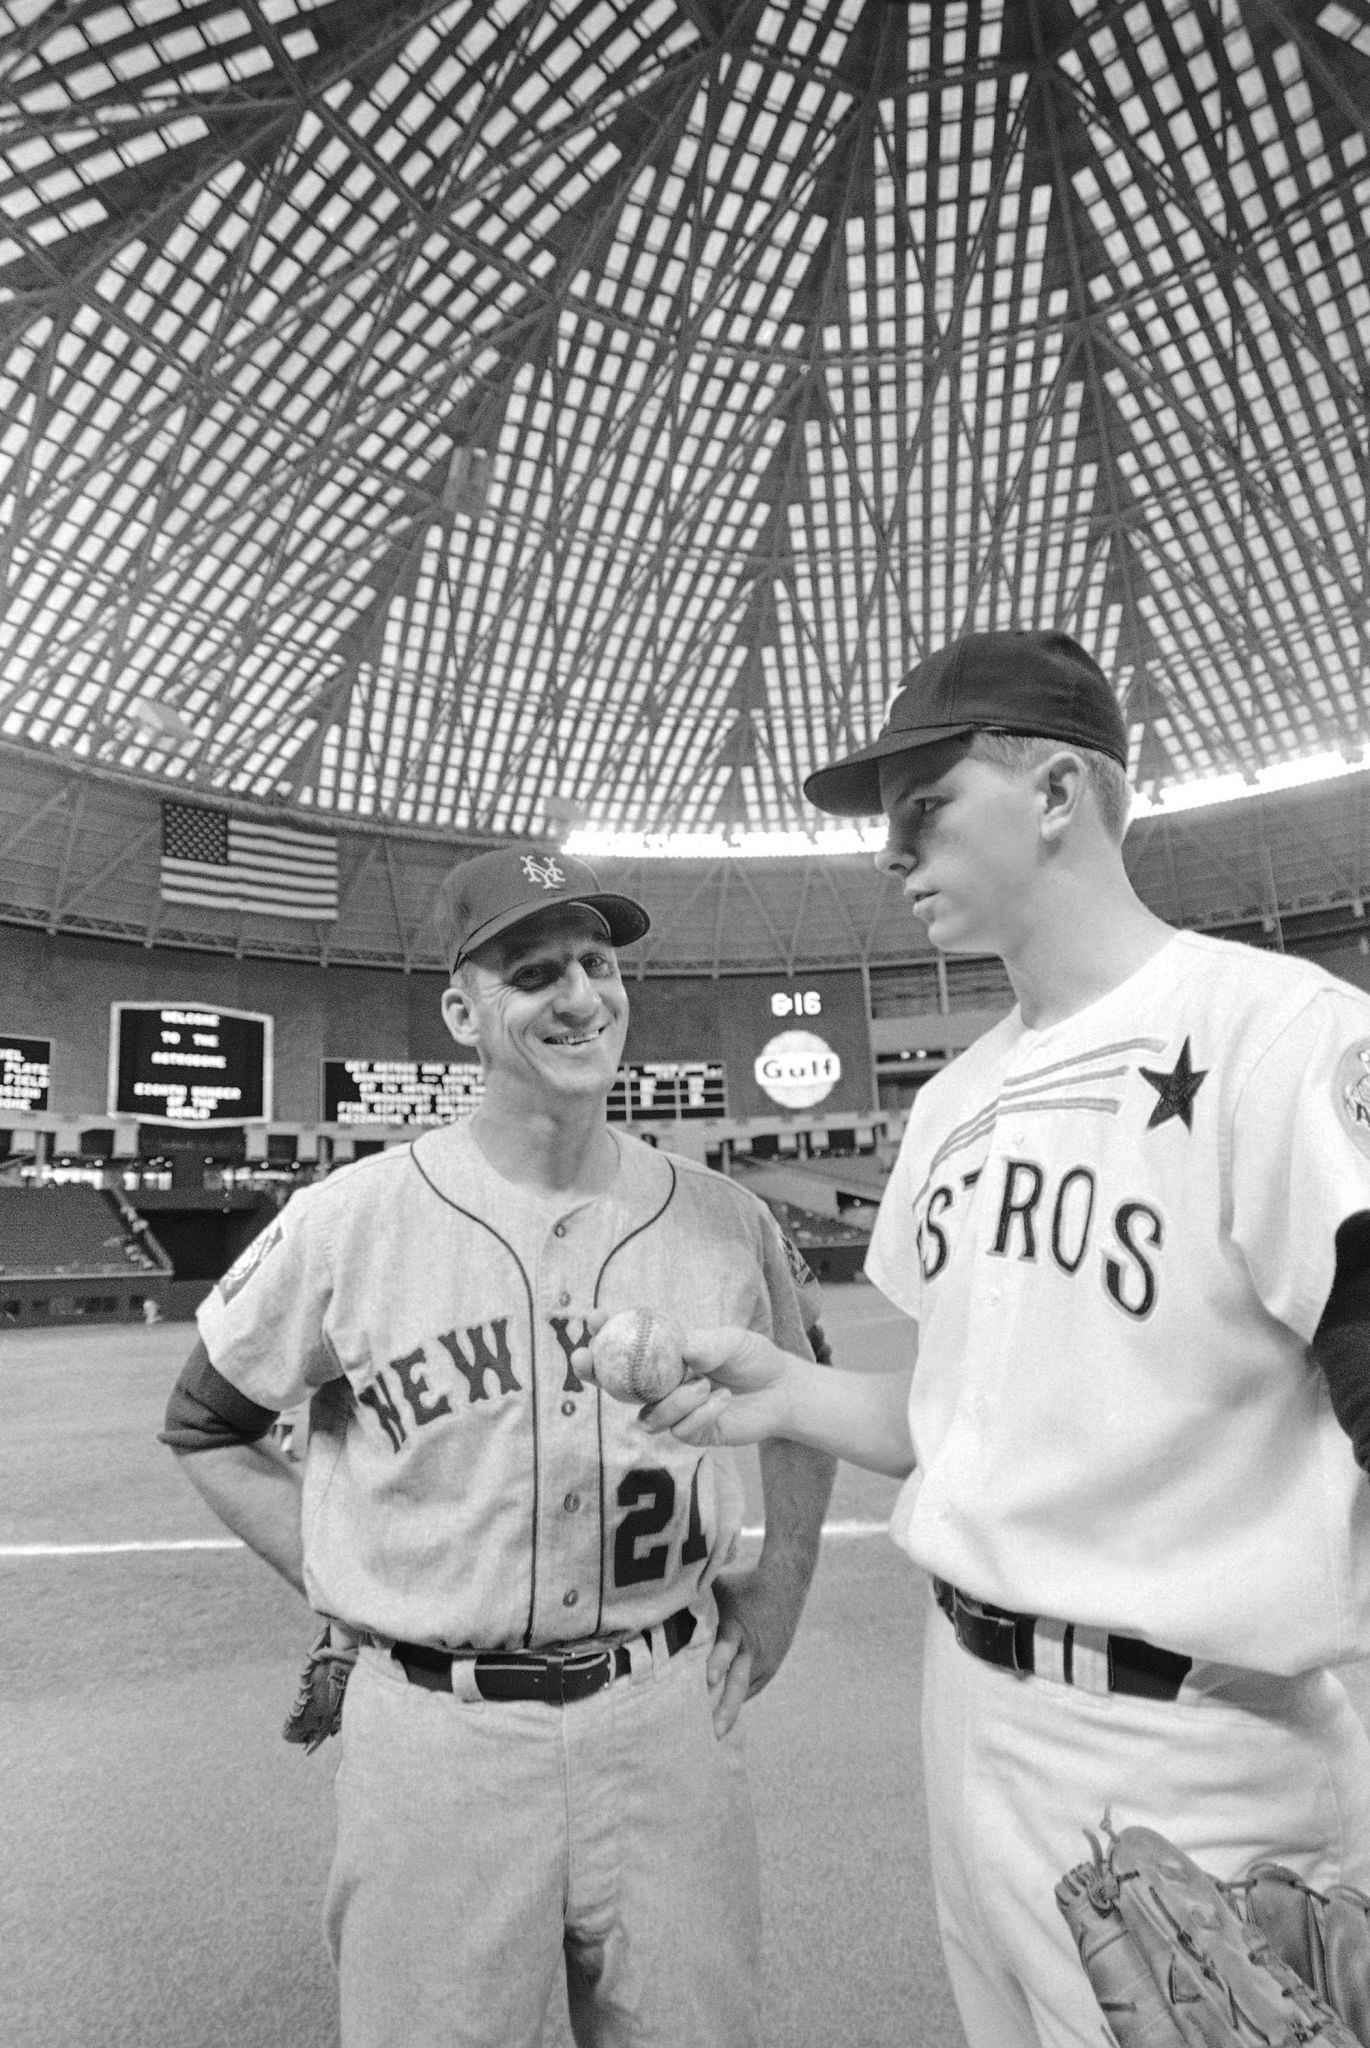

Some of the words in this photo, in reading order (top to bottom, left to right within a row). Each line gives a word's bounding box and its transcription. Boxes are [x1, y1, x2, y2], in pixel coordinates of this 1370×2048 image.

[161, 1010, 220, 1027] WELCOME
[161, 1031, 181, 1045] TO
[192, 1033, 219, 1048] THE
[151, 1051, 227, 1069] ASTRODOME
[763, 1058, 831, 1079] Gulf
[133, 1082, 188, 1097] EIGHTH
[190, 1085, 242, 1100] WONDER
[166, 1096, 187, 1107] OF
[191, 1097, 218, 1110] THE
[166, 1106, 210, 1120] WORLD
[916, 1159, 1163, 1320] SROS
[357, 1317, 523, 1454] NEW
[613, 1454, 708, 1588] 21
